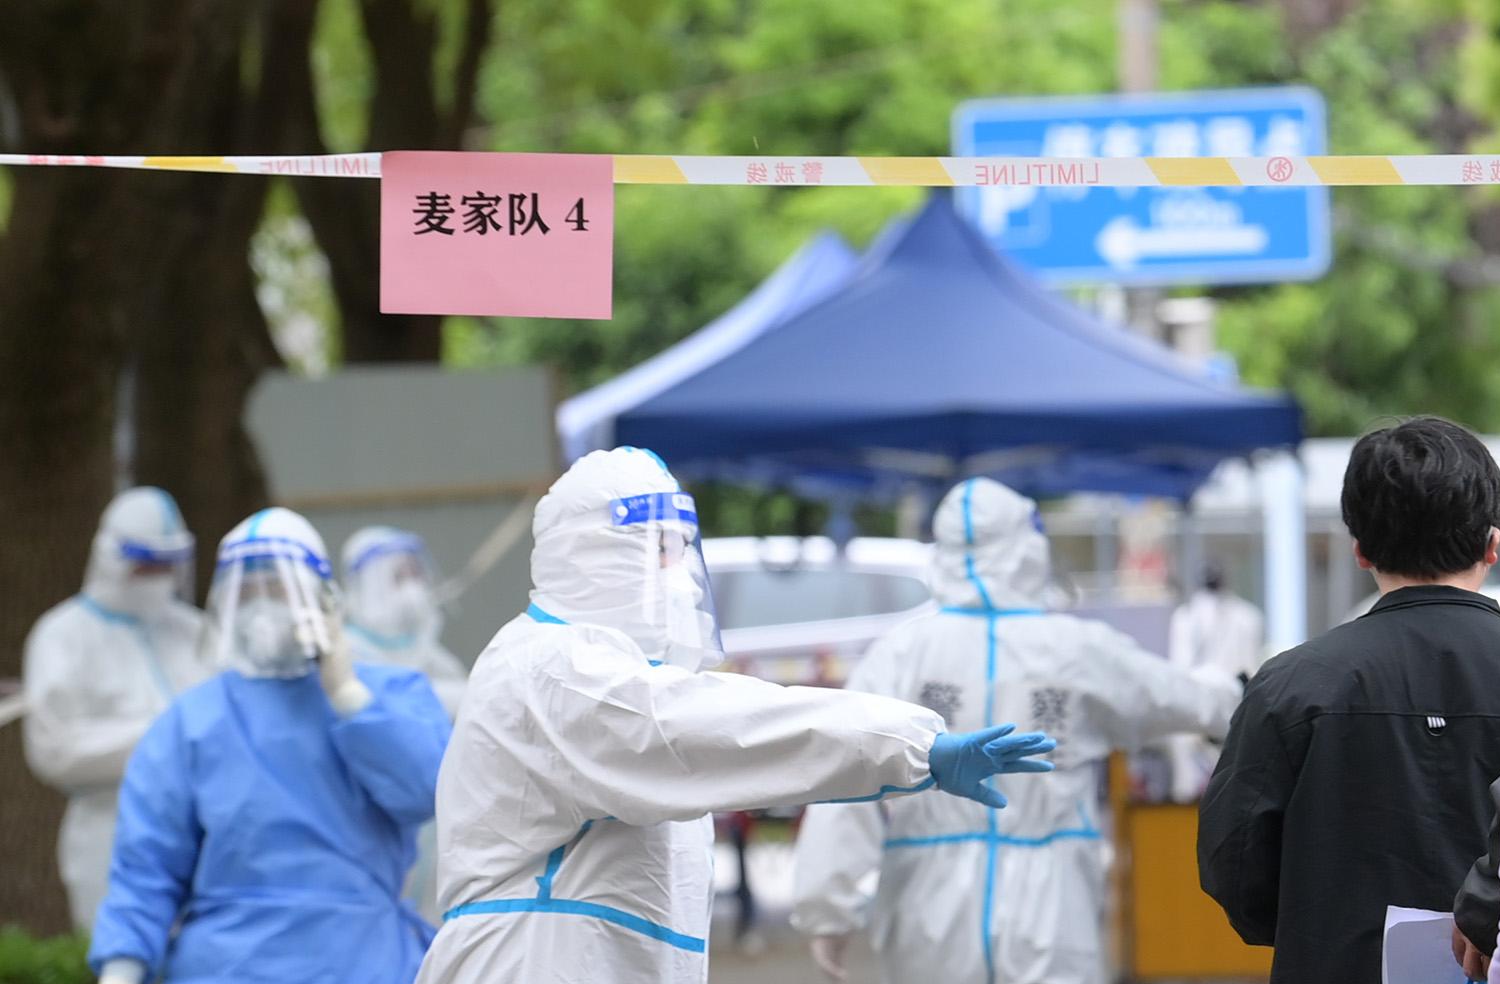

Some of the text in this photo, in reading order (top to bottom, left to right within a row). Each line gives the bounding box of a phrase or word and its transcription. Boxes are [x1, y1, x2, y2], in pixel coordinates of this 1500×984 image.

[411, 190, 590, 236] 麦家队 4
